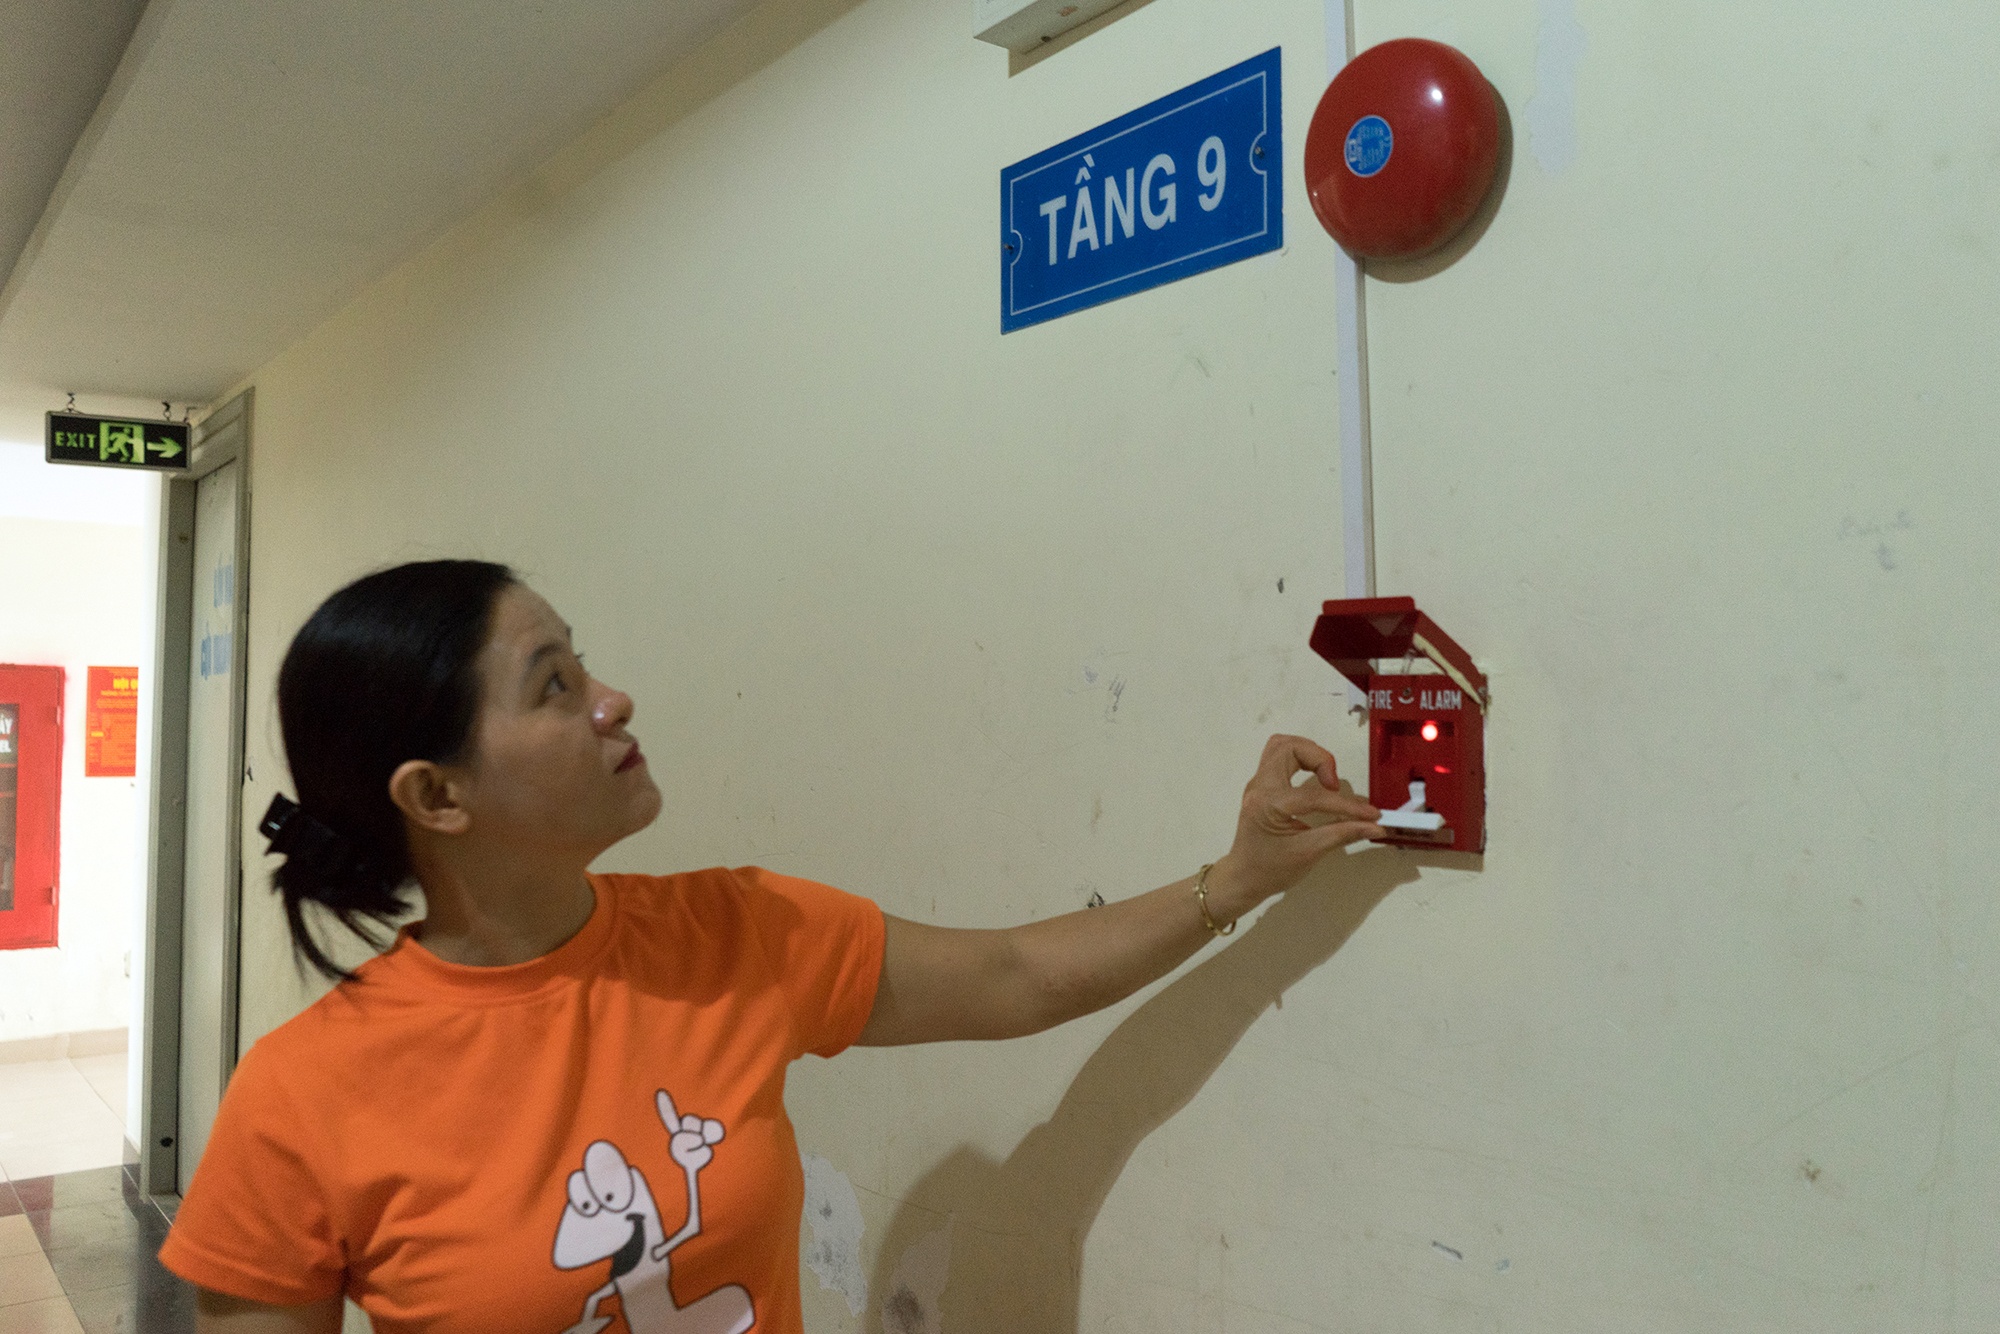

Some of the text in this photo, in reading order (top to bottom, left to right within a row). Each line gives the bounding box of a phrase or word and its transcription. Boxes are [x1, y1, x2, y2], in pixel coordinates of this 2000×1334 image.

[1039, 135, 1227, 266] TẦNG 9
[55, 431, 97, 449] EXIT
[1369, 689, 1462, 710] FIRE ALARM
